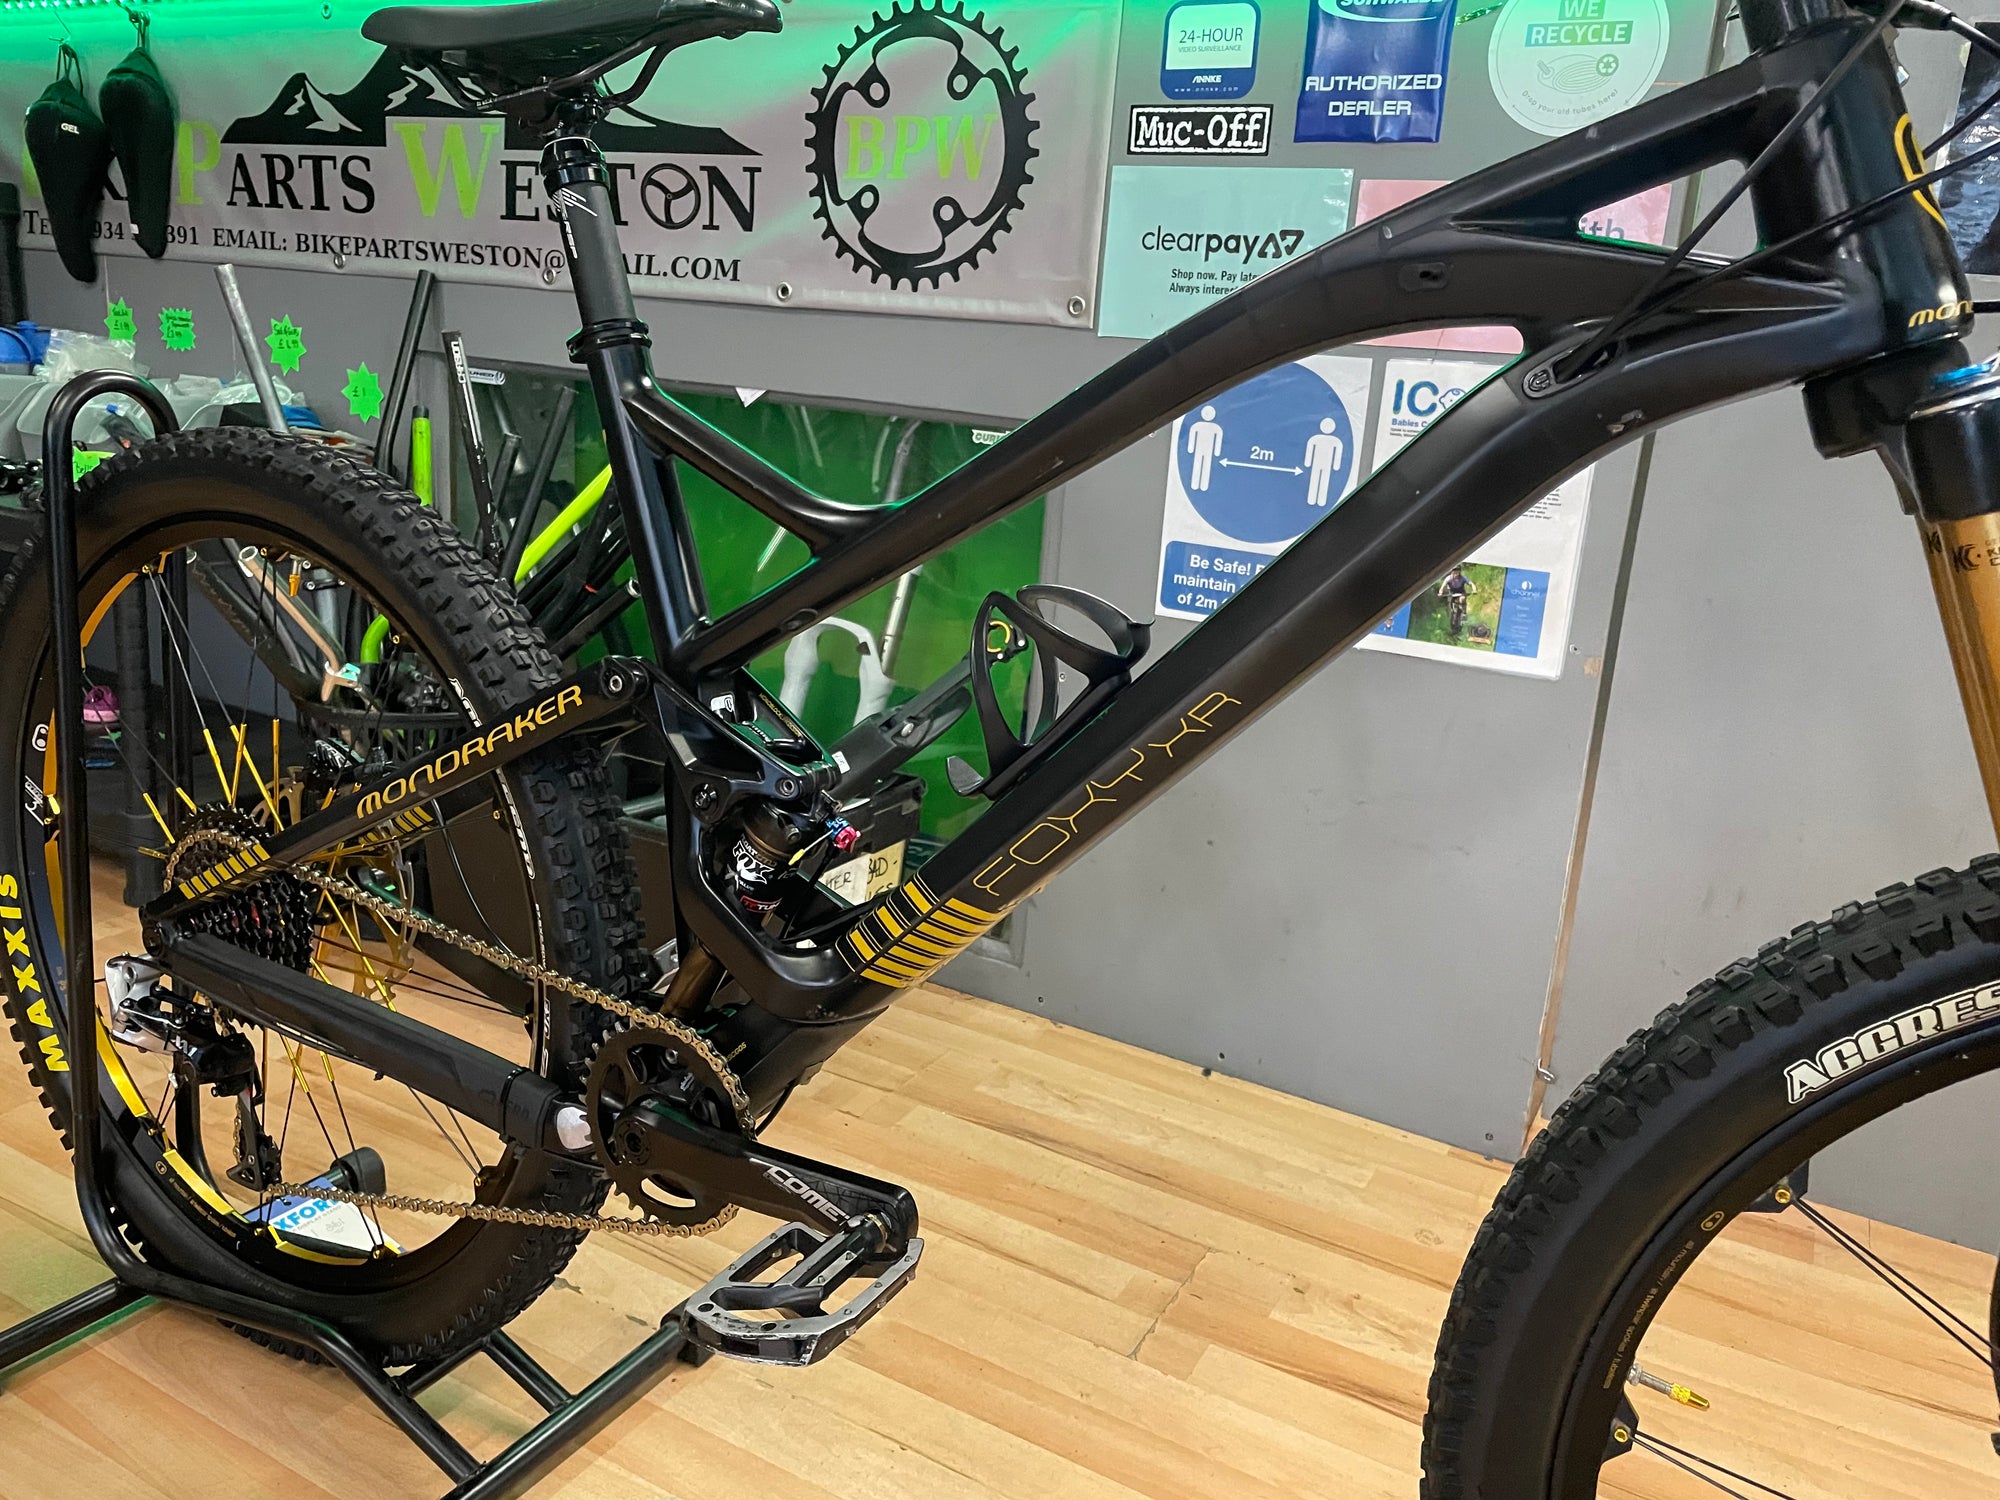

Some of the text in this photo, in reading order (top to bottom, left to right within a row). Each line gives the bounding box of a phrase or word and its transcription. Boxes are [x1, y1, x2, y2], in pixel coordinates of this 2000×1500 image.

[1565, 0, 1599, 17] WE
[1179, 27, 1243, 44] 24-HOUR
[1531, 24, 1628, 44] RECYCLE
[1198, 44, 1241, 53] SURVEILLANCE
[1192, 75, 1222, 84] ANNKE
[1305, 74, 1443, 92] AUTHORIZED
[1328, 100, 1412, 117] DEALER
[1521, 90, 1537, 106] Drop
[1538, 103, 1554, 113] your
[1557, 107, 1570, 115] old
[1573, 104, 1596, 114] tubes
[61, 122, 80, 135] GEL
[1136, 112, 1264, 148] Muc-Off
[843, 114, 998, 182] BPW
[176, 120, 763, 233] PARTS WETON
[212, 227, 288, 252] EMAIL:
[295, 233, 741, 282] BIKEPARTSWESTON@AIL.COM
[1142, 225, 1260, 265] clearpay
[1171, 268, 1258, 283] Shop now. Pay late
[1169, 282, 1237, 295] Always intere
[1908, 300, 1972, 328] MON
[1391, 418, 1418, 428] Babies
[1250, 445, 1274, 461] 2m
[1190, 554, 1209, 570] Be
[1213, 558, 1251, 576] Safe!
[1173, 573, 1236, 593] maintain
[1177, 592, 1218, 610] of 2m
[356, 685, 583, 819] MONDRAKER
[0, 873, 70, 1073] MAXXIS
[1784, 980, 2000, 1104] AGGRES
[273, 1198, 334, 1230] XFOR
